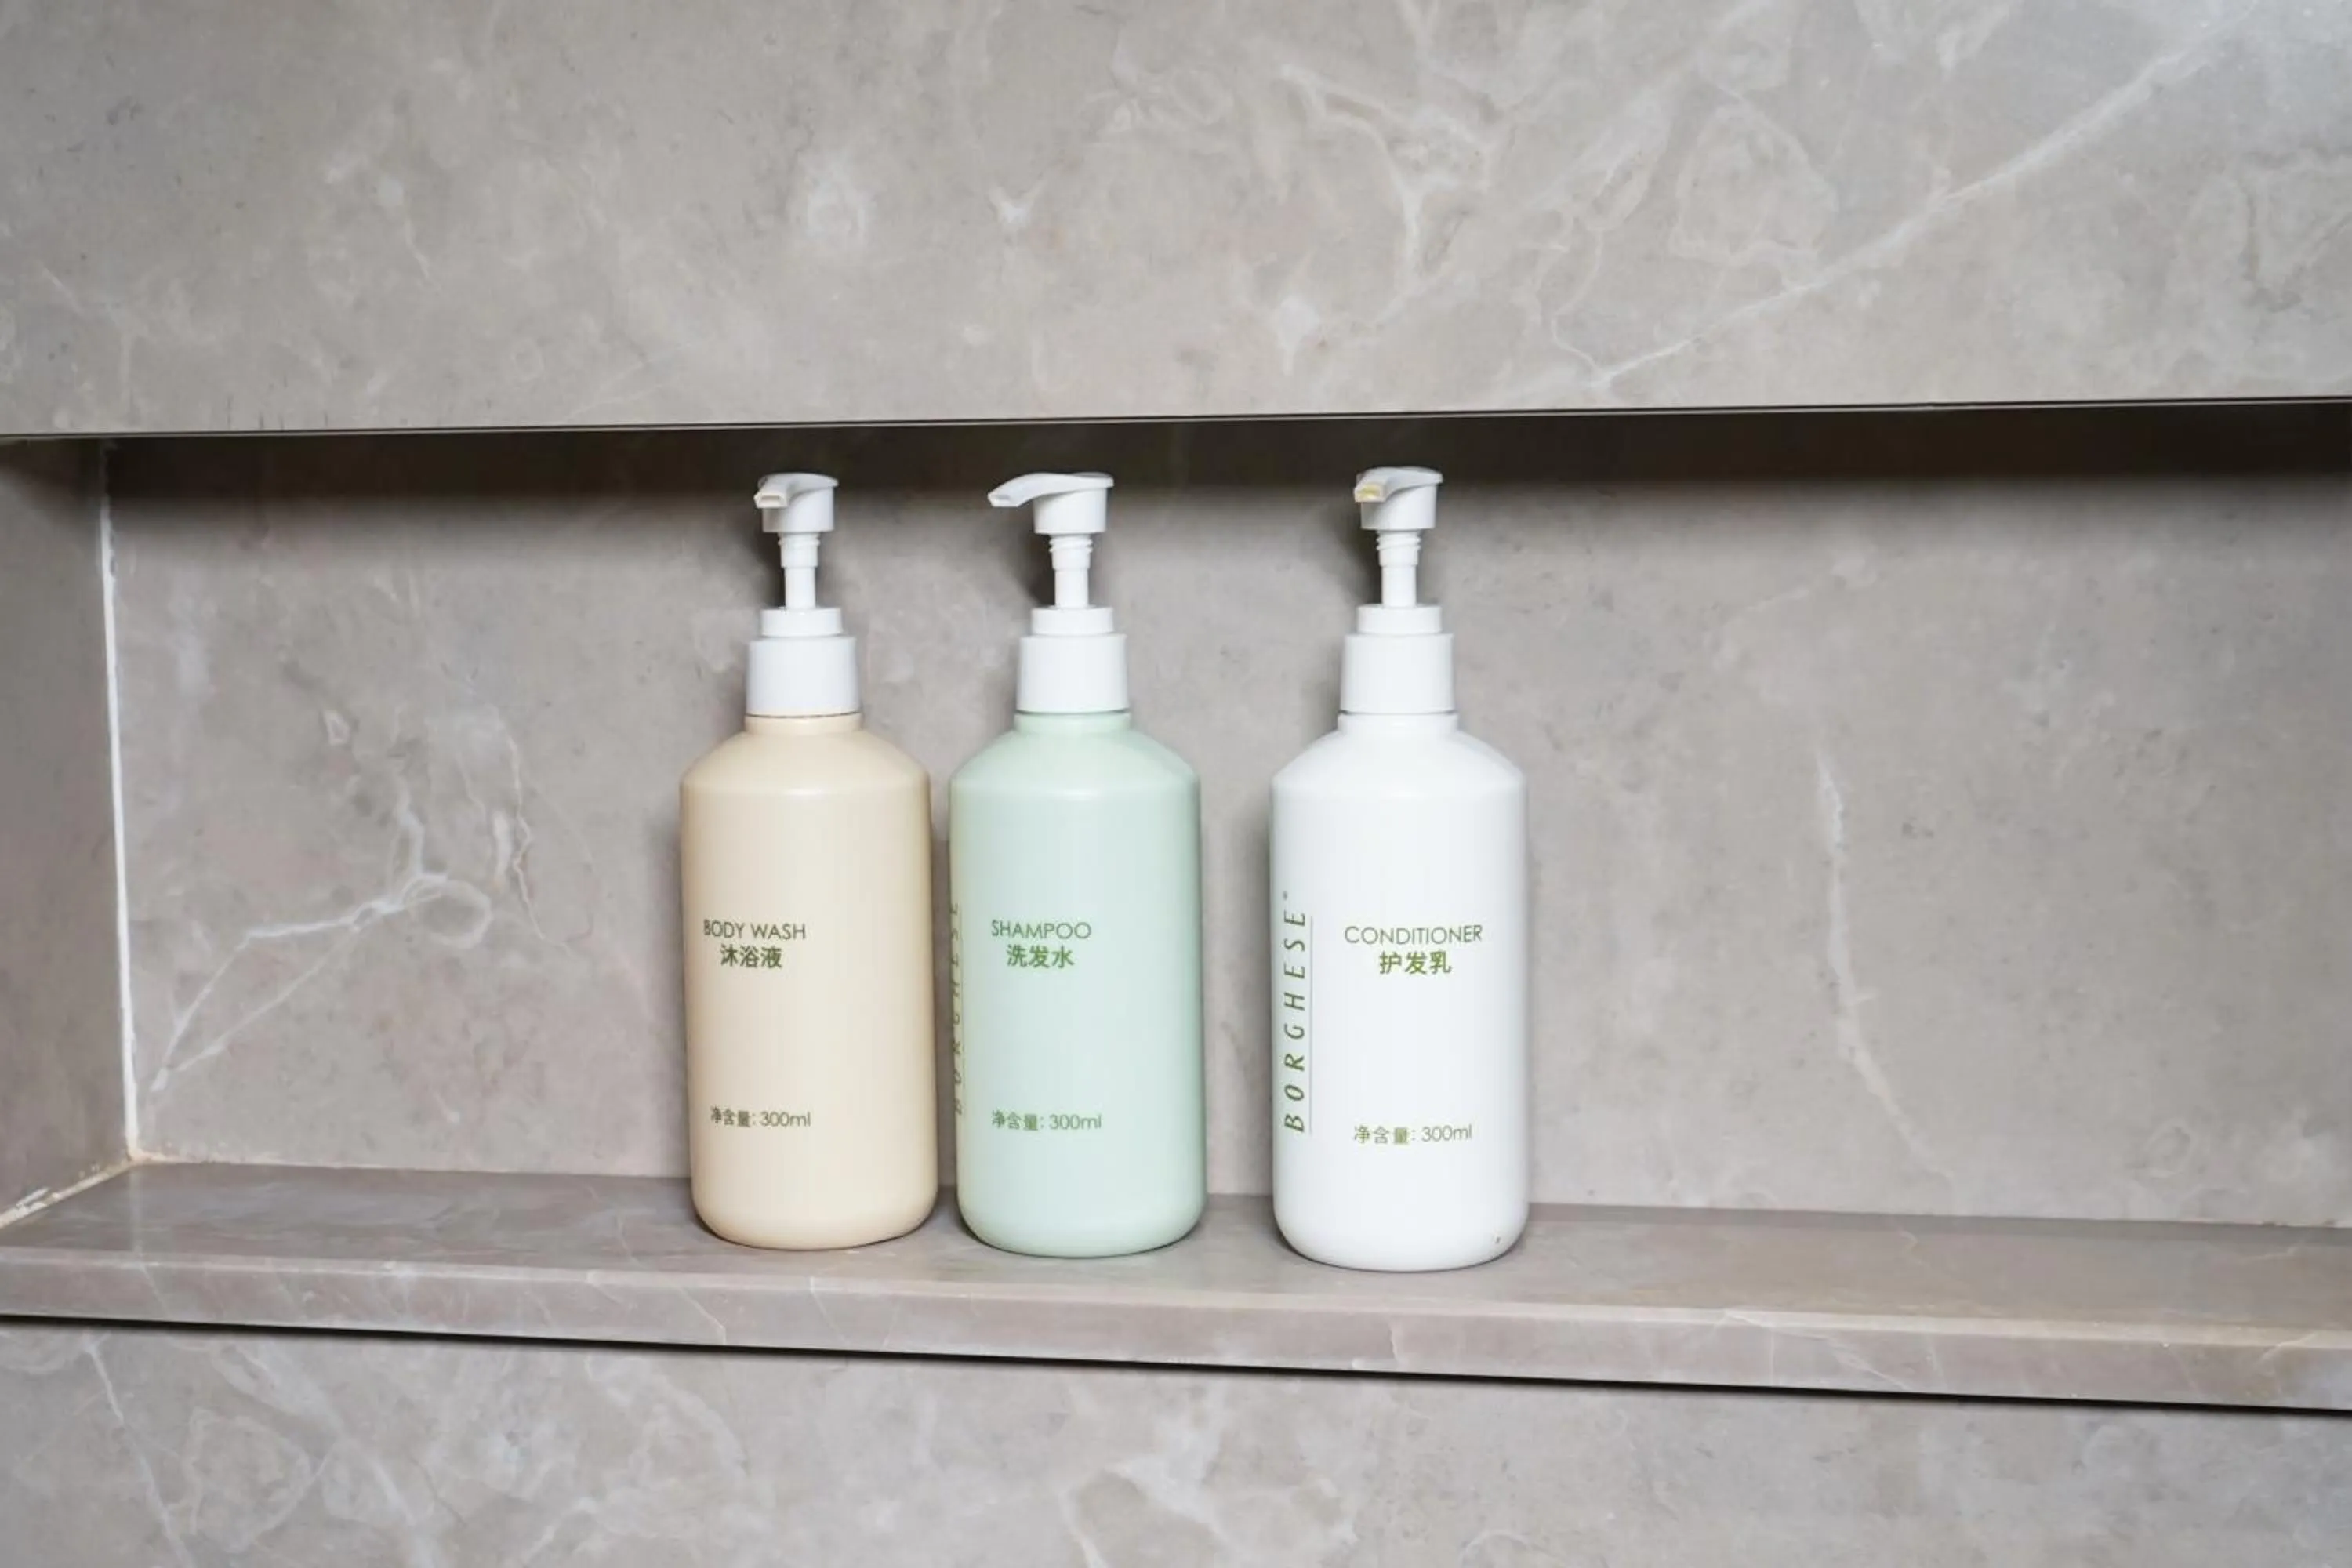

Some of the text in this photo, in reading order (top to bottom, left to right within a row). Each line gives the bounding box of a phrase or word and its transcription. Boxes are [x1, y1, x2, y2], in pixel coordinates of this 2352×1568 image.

[703, 919, 807, 939] BODY WASH
[991, 920, 1091, 939] SHAMPOO
[1345, 925, 1483, 944] CONDITIONER
[720, 944, 782, 968] 沐浴液
[1007, 945, 1074, 968] 洗发水
[1379, 951, 1452, 975] 护发乳
[1283, 910, 1306, 1132] BORGHESE
